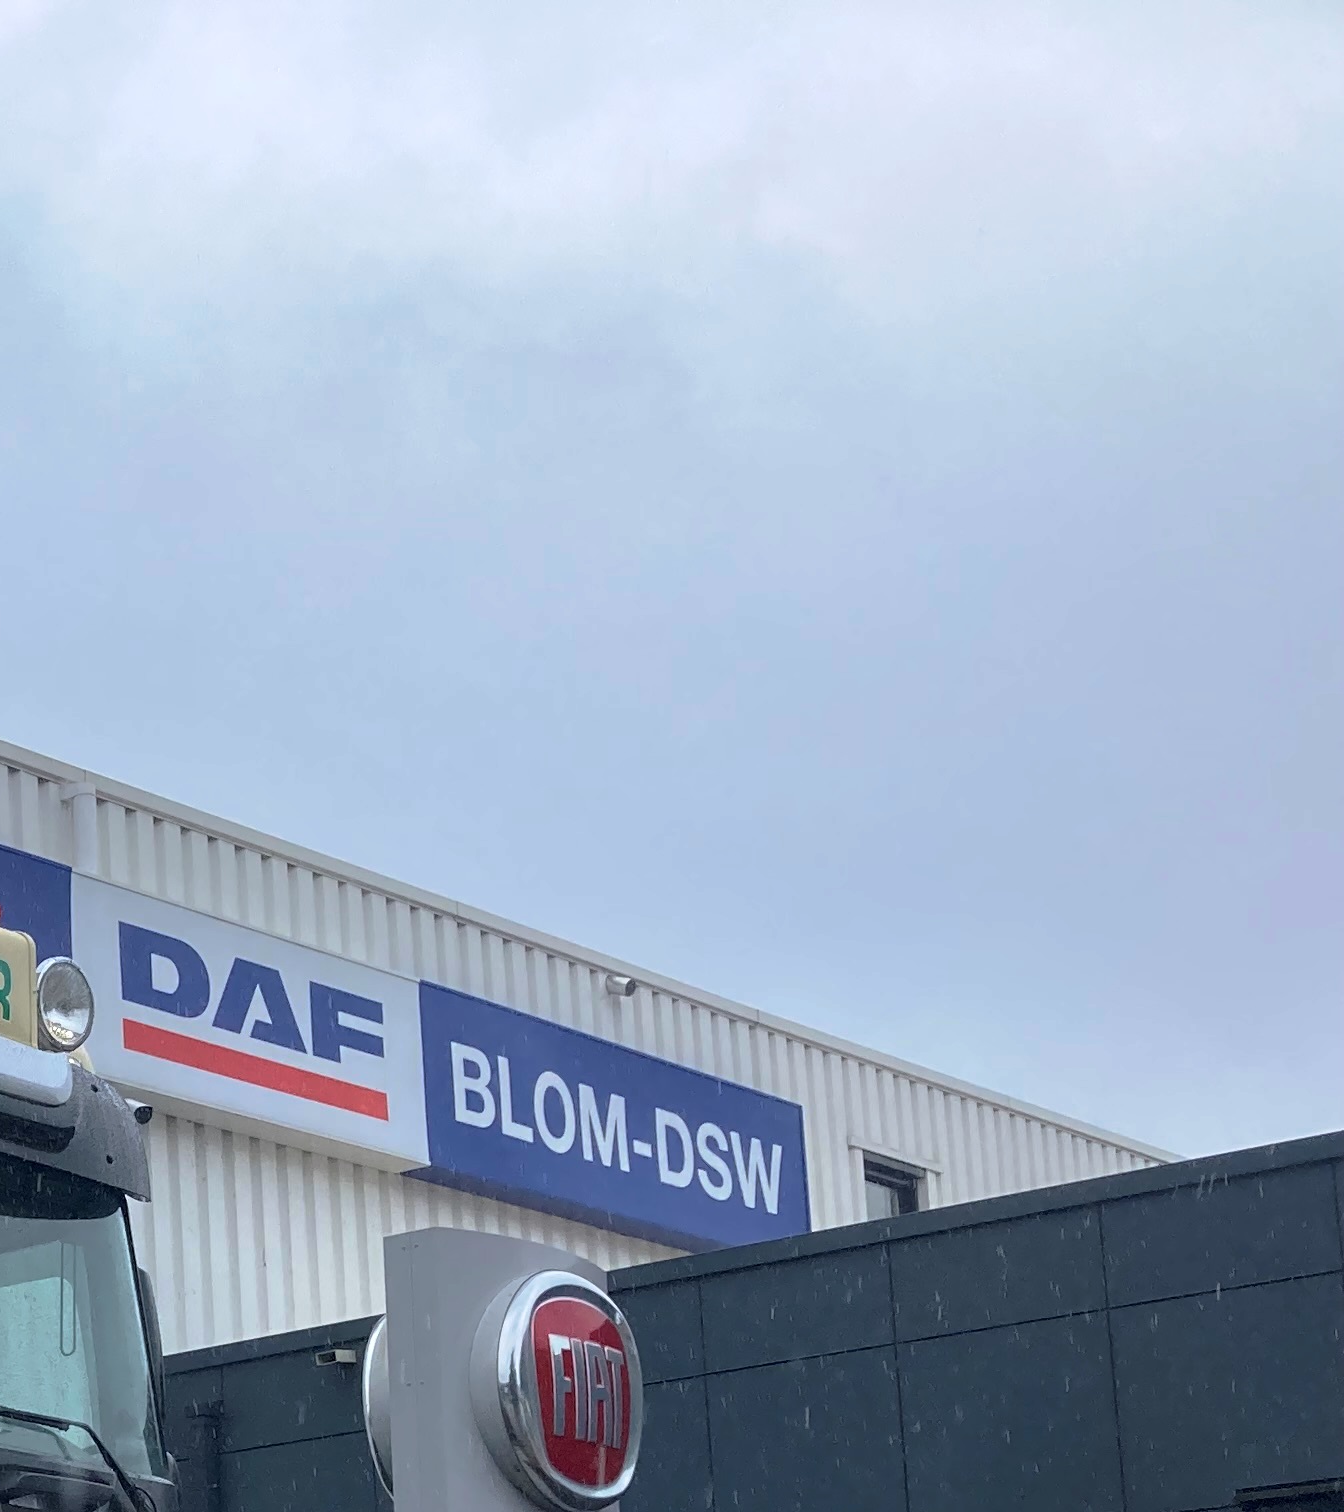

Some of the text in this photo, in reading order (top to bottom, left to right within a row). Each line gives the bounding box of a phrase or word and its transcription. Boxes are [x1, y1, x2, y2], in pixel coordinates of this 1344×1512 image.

[118, 921, 386, 1064] DAF
[449, 1041, 784, 1215] BLOM-DSW
[548, 1333, 626, 1449] FIAT
